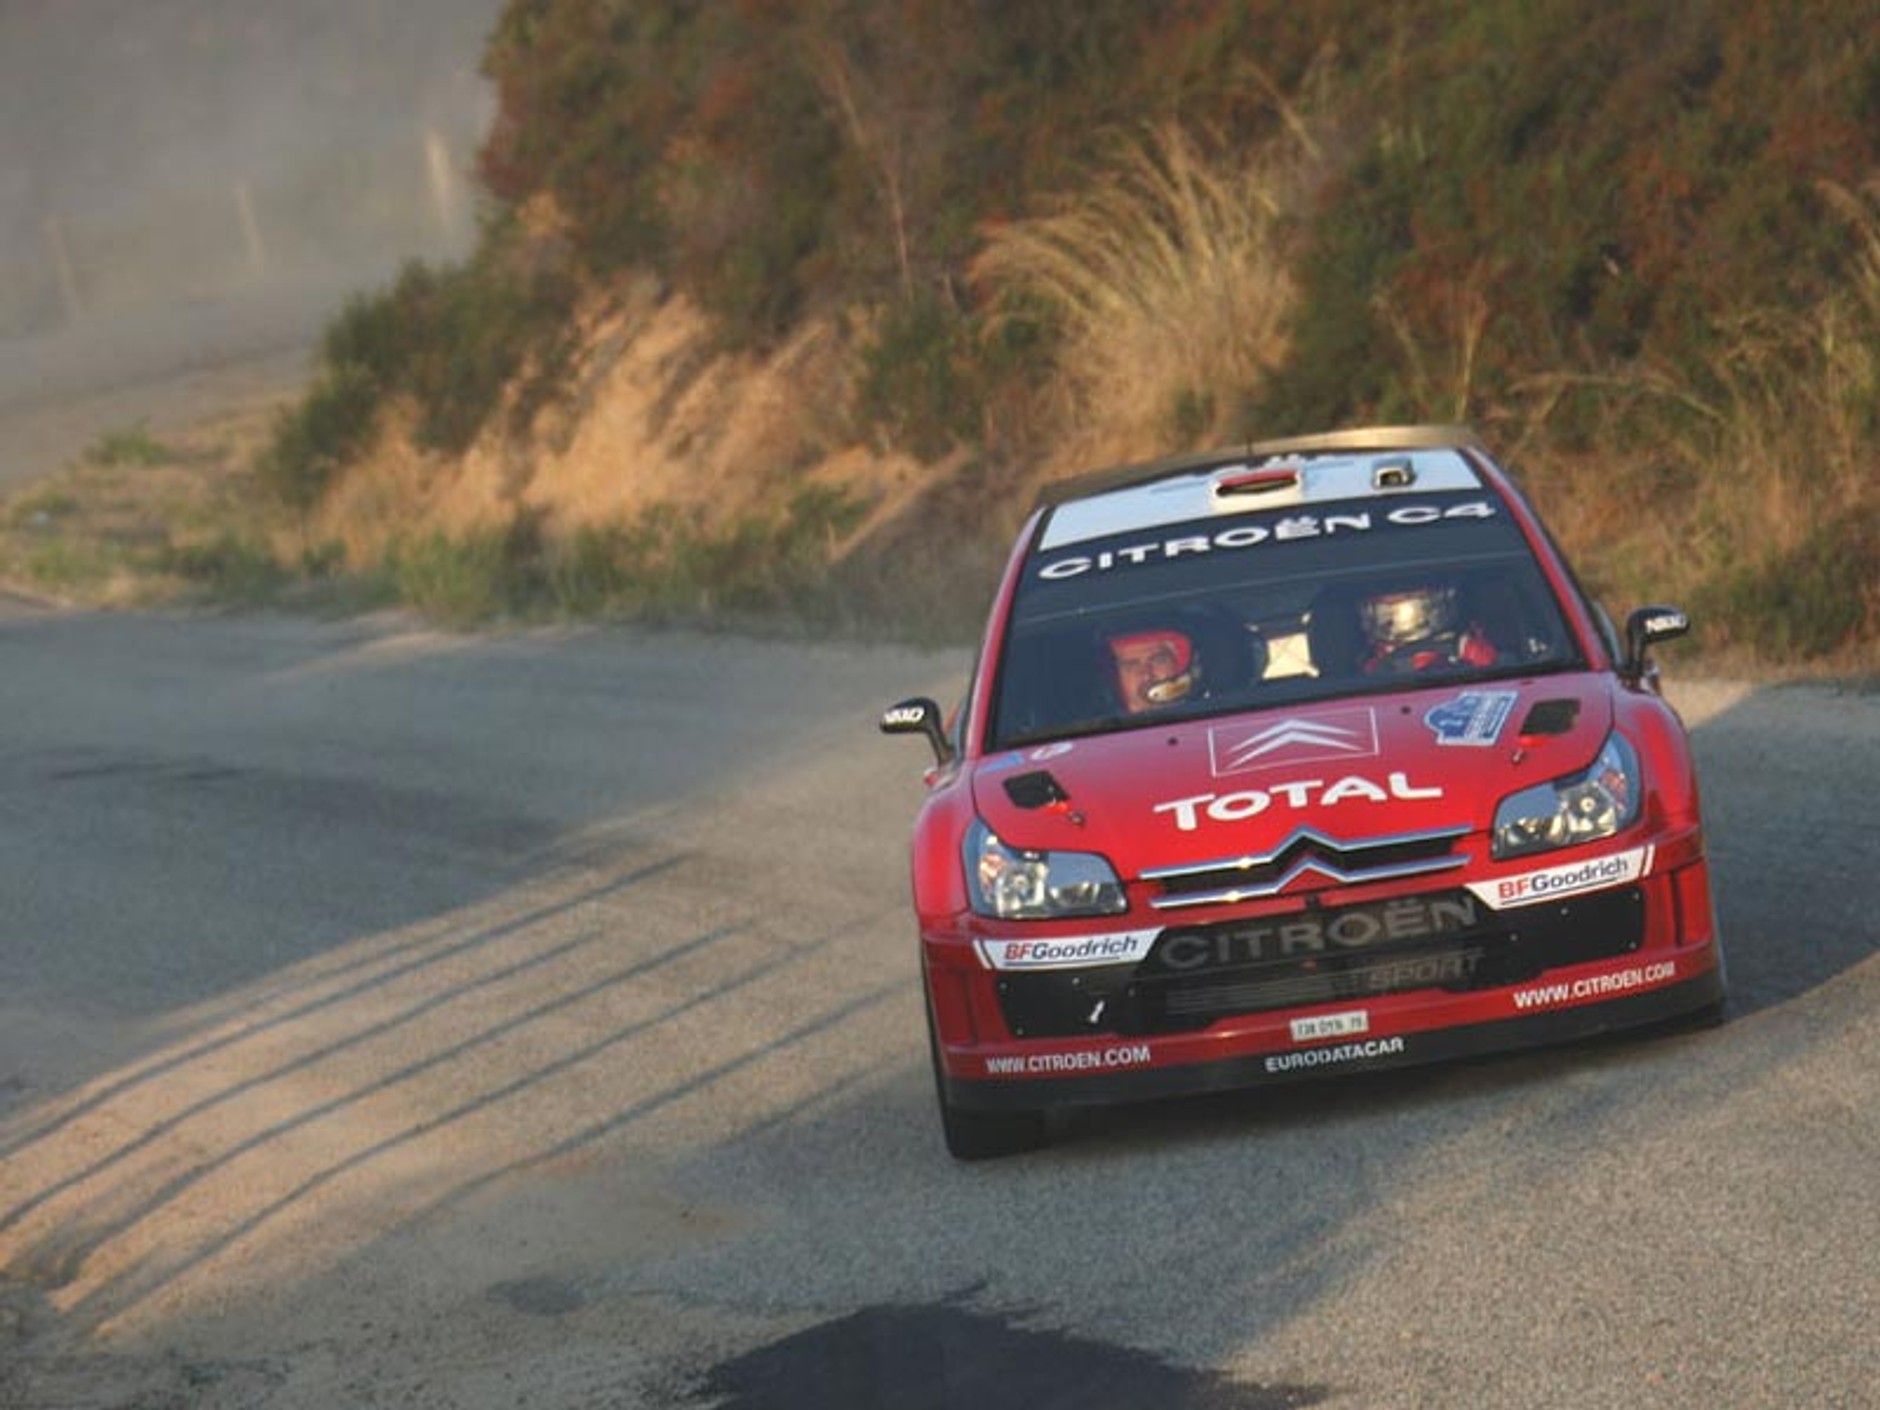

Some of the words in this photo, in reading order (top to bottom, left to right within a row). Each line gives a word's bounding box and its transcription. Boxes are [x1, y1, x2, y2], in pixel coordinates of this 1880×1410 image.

[1038, 513, 1371, 579] CITROËN
[1387, 502, 1496, 524] C4
[1153, 772, 1443, 831] TOTAL
[1498, 857, 1628, 899] BFGoodrich
[1004, 935, 1138, 961] BFGoodrich
[1160, 897, 1477, 969] CITROËN
[1368, 945, 1486, 990] SPORT
[1513, 961, 1675, 1008] WWW.CITROEN.COM
[986, 1046, 1151, 1073] WWW.CITROEN.COM
[1265, 1037, 1404, 1072] EURODATACAR
